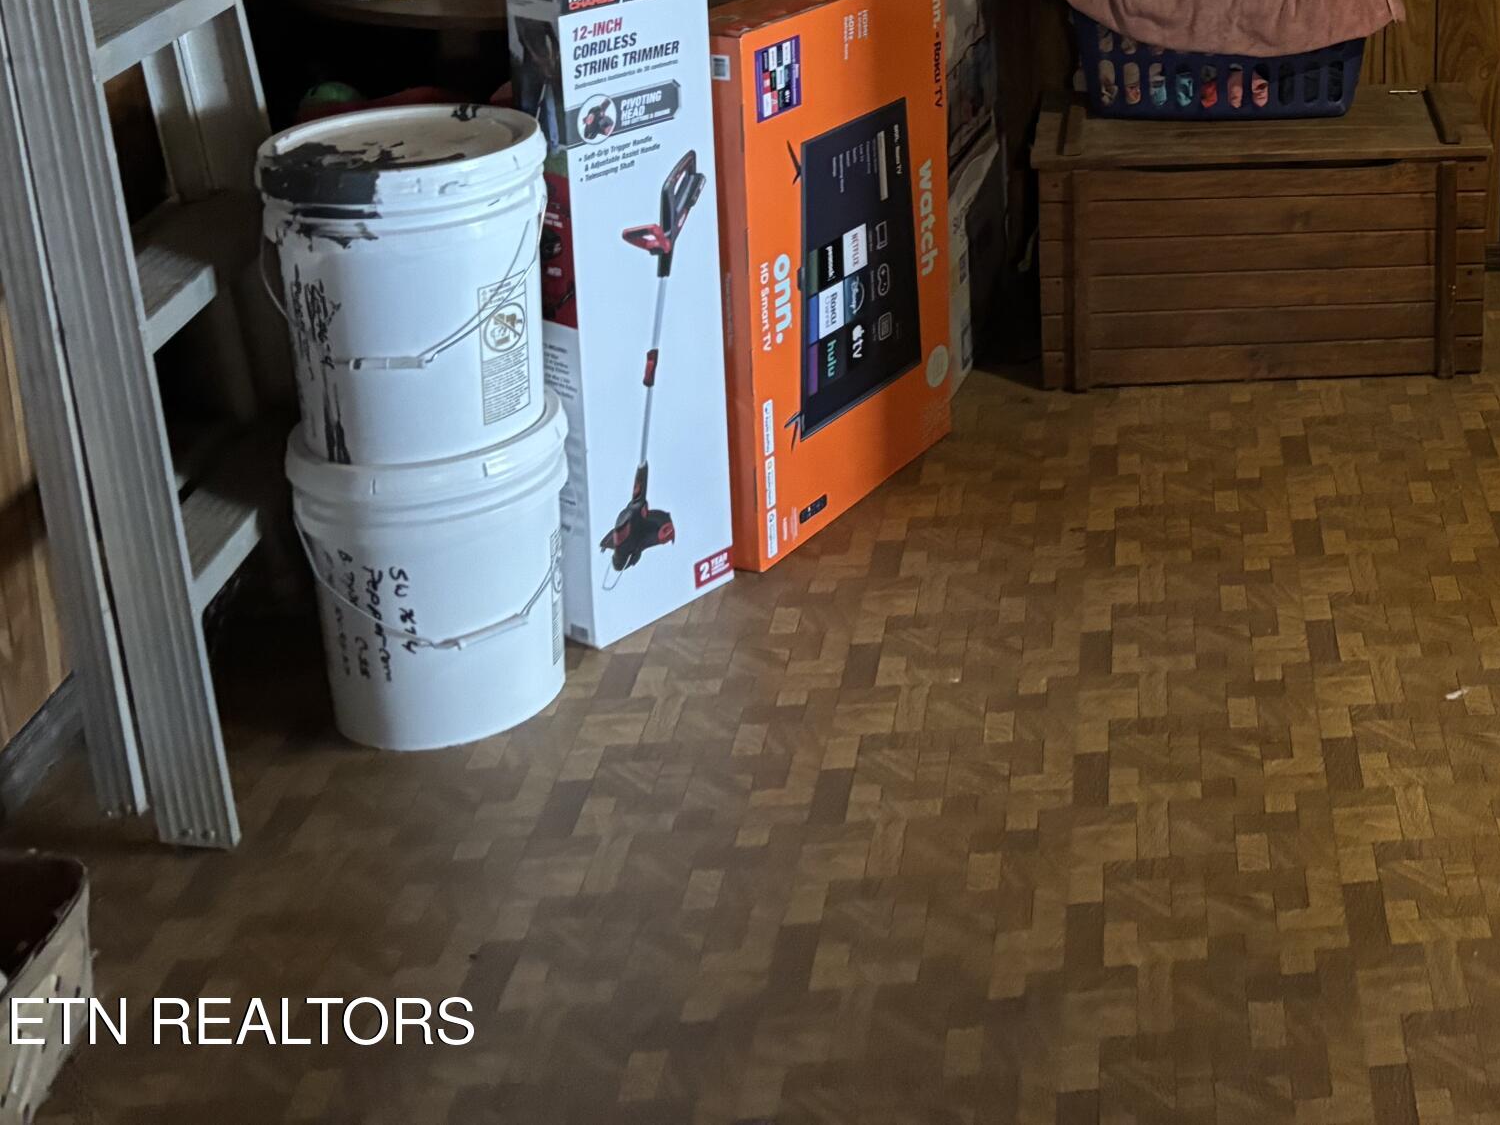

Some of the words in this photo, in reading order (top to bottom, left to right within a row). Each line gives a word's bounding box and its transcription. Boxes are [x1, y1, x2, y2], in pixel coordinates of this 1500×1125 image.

[572, 16, 623, 43] 12-INCH
[573, 32, 638, 61] CORDLESS
[573, 54, 619, 80] STRING
[622, 40, 680, 67] TRIMMER
[620, 90, 663, 111] PIVOTING
[934, 86, 943, 108] TV
[620, 105, 646, 121] HEAD
[919, 158, 940, 277] watch
[851, 232, 860, 266] NETFLIX
[760, 261, 769, 285] HD
[761, 287, 770, 332] Smart
[773, 253, 793, 345] onn.
[762, 331, 772, 352] TV
[826, 338, 837, 379] hulu
[700, 561, 710, 582] 2
